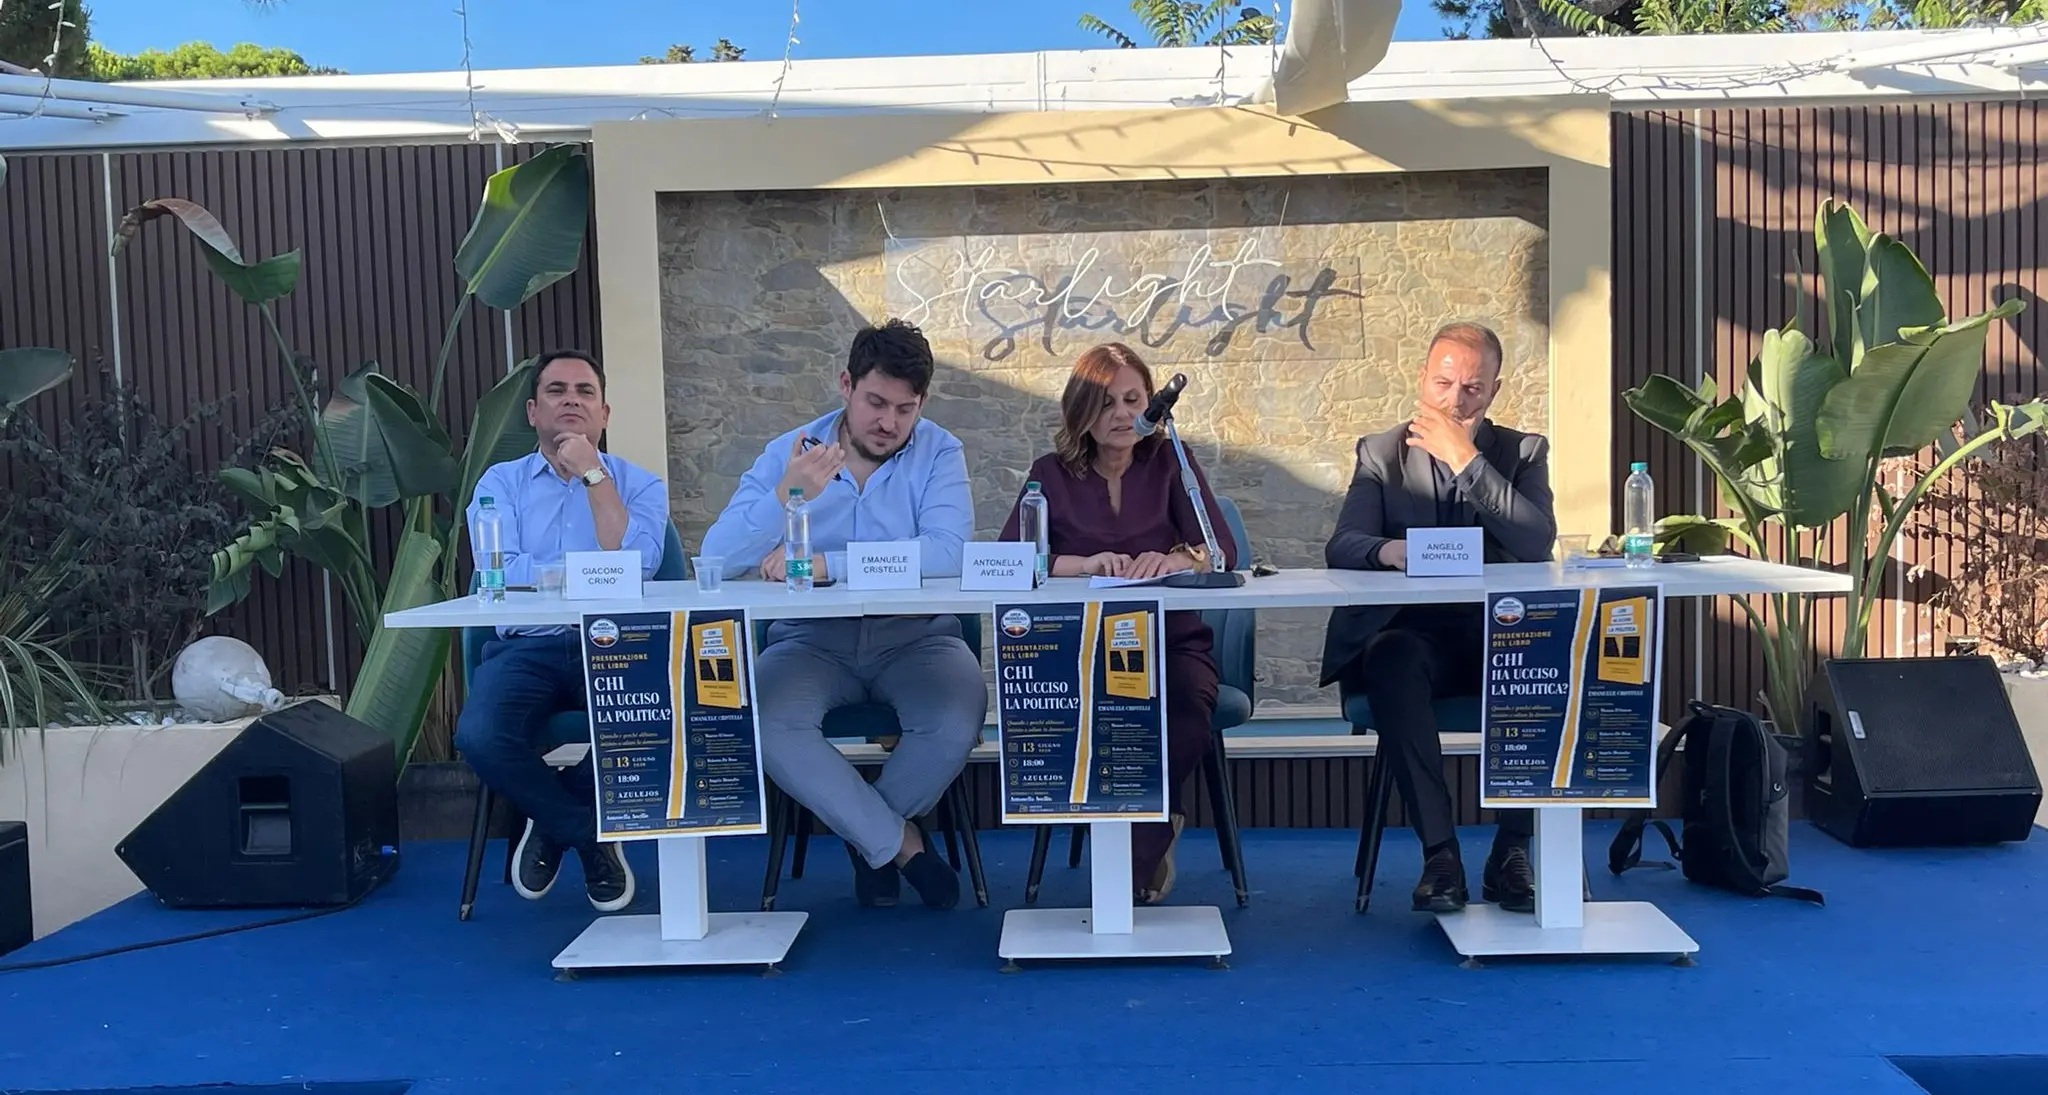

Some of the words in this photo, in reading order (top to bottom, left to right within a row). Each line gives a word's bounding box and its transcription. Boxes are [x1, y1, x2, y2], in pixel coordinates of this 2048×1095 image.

[897, 237, 1282, 327] Starlight
[1426, 543, 1464, 551] ANGELO
[861, 556, 908, 564] EMANUELE
[973, 559, 1023, 567] ANTONELLA
[582, 567, 623, 575] GIACOMO
[864, 566, 906, 574] CRISTELLI
[980, 569, 1014, 577] AVELLIS
[588, 577, 618, 585] CRINO'
[1492, 653, 1523, 667] CHI
[1004, 666, 1033, 679] CHI
[1492, 669, 1510, 681] HA
[1513, 668, 1558, 680] UCCISO
[594, 676, 624, 691] CHI
[1005, 682, 1023, 694] HA
[1026, 682, 1068, 693] UCCISO
[1491, 685, 1508, 696] LA
[1510, 683, 1568, 695] POLITICA?
[596, 694, 614, 706] HA
[616, 692, 660, 705] UCCISO
[1005, 698, 1021, 710] LA
[1023, 697, 1079, 710] POLITICA?
[598, 711, 612, 723] LA
[615, 709, 671, 722] POLITICA?
[1506, 728, 1518, 737] 13
[1023, 742, 1034, 752] 13
[617, 756, 629, 767] 13
[618, 775, 640, 783] 18:00
[618, 790, 659, 798] AZULEJOS
